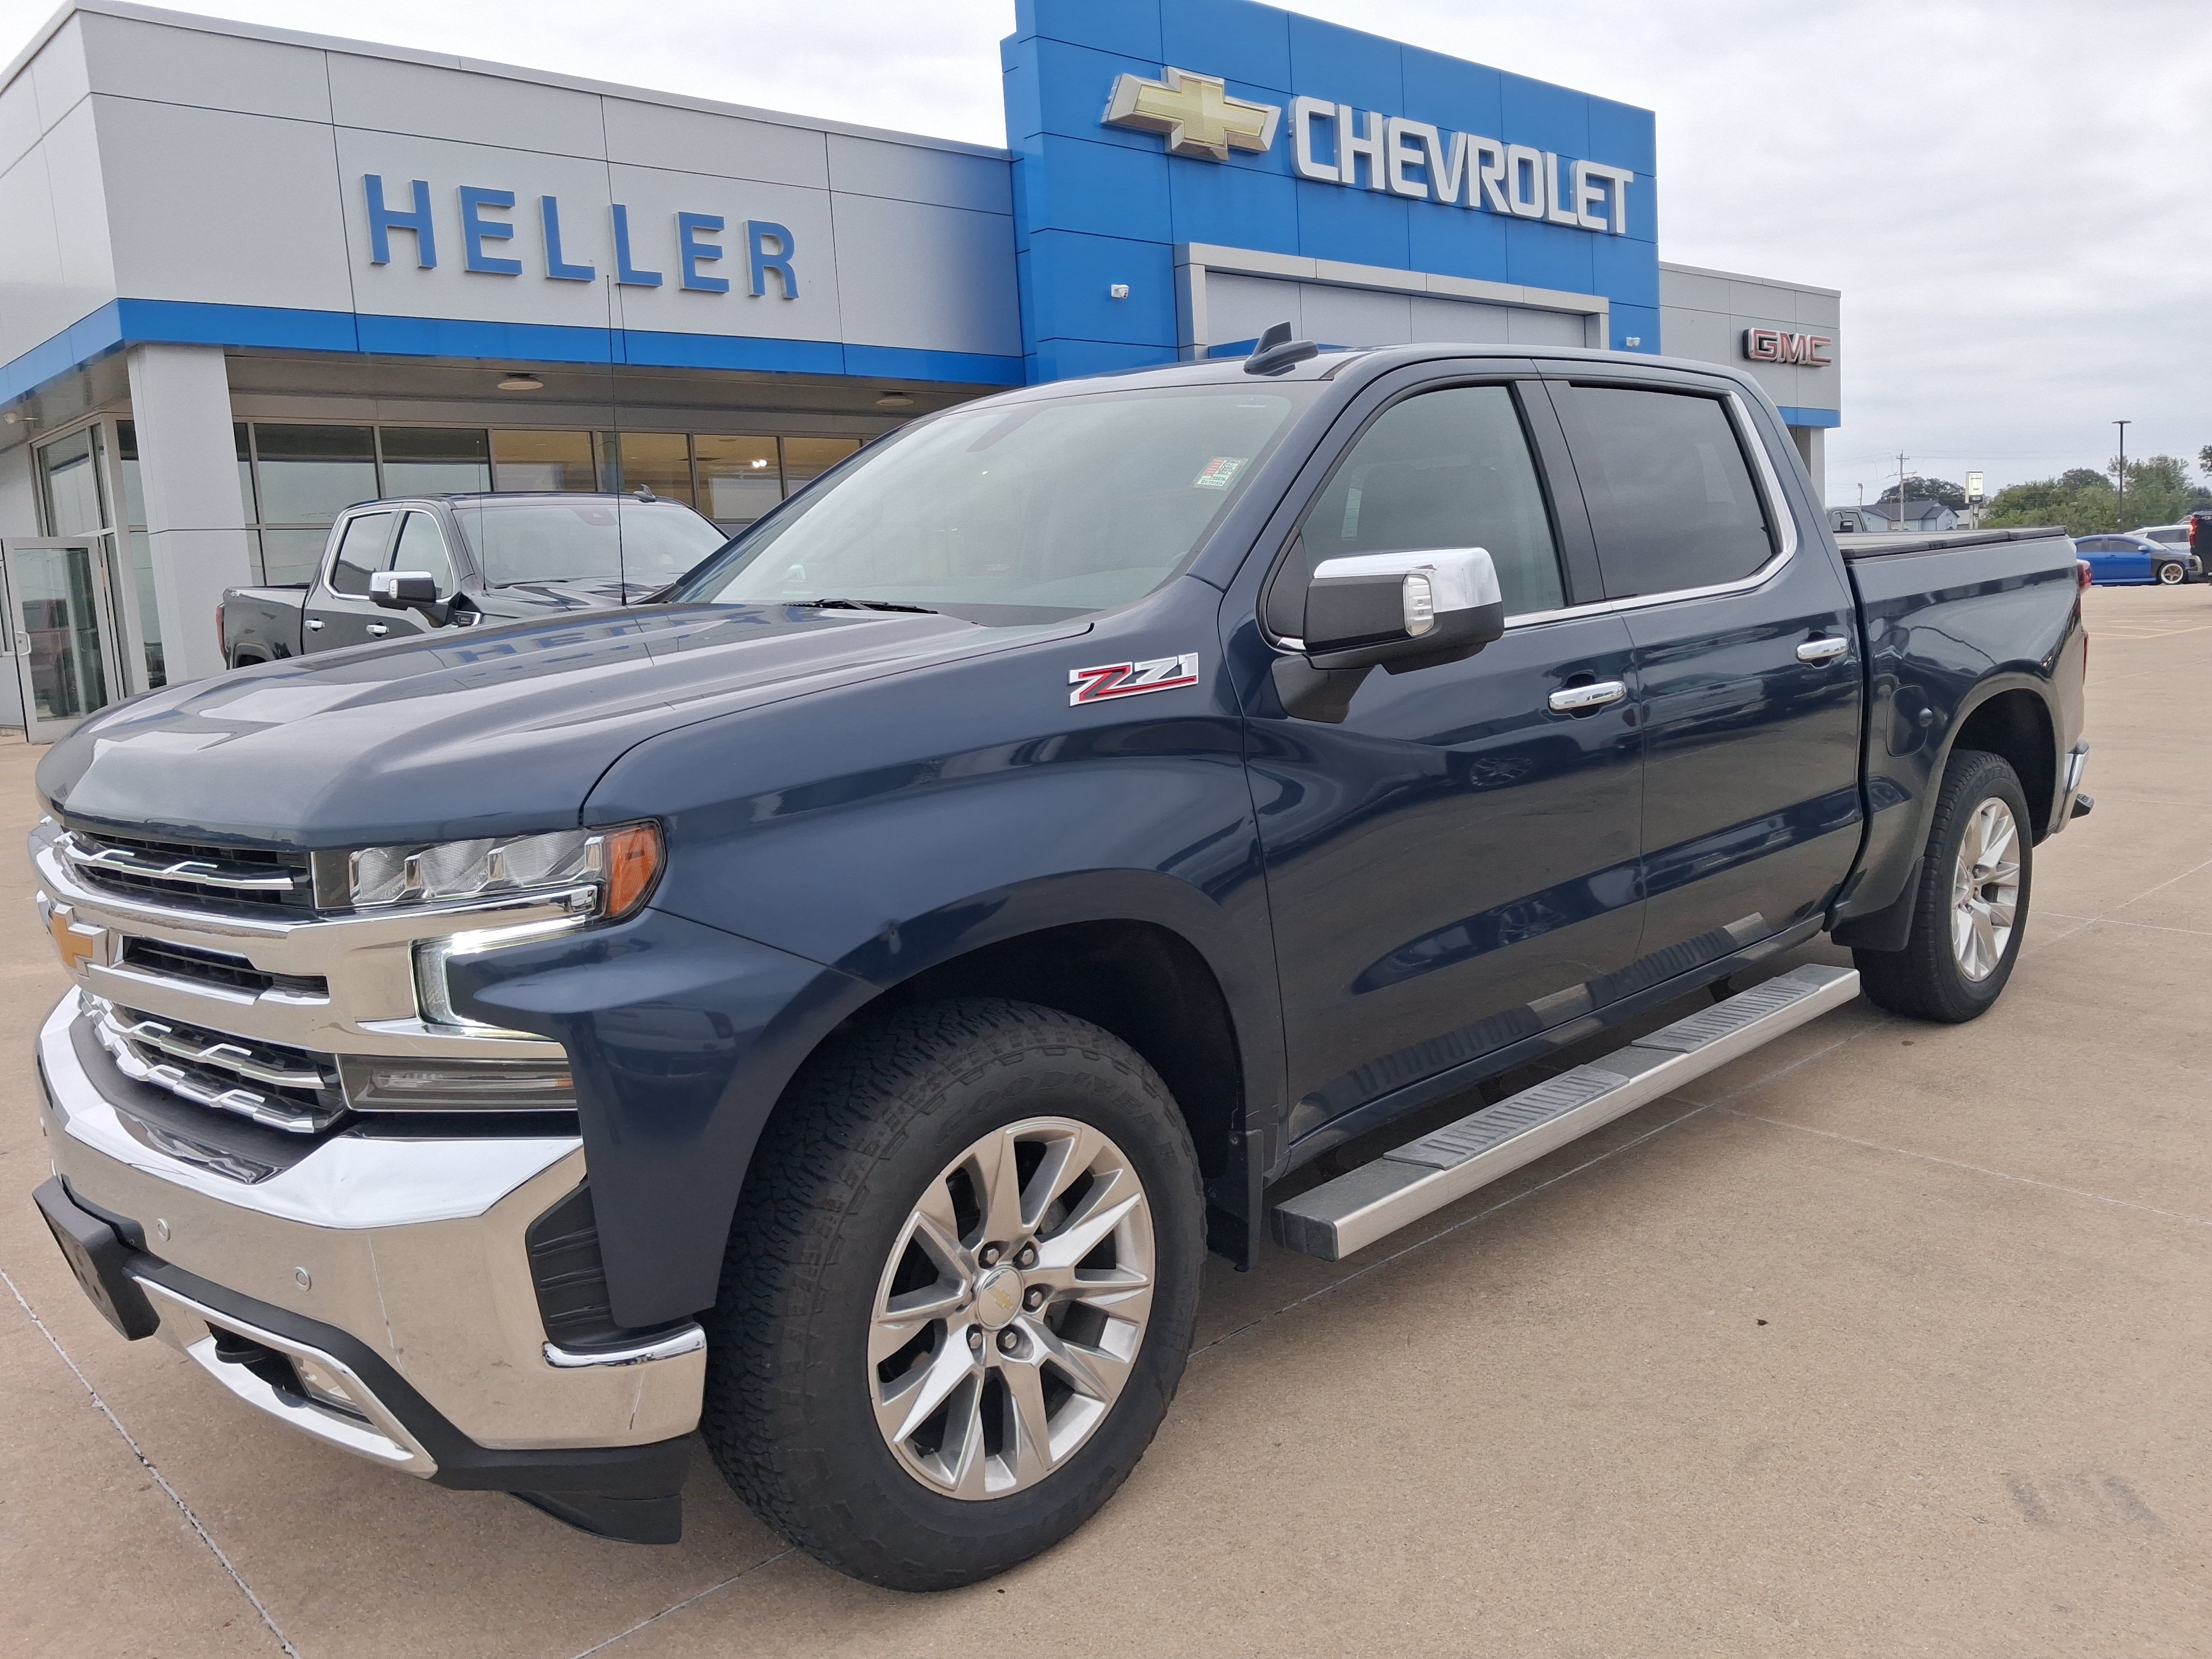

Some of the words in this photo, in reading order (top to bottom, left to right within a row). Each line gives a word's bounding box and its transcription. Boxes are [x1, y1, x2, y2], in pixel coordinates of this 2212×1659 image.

[1288, 95, 1634, 234] CHEVROLET
[361, 173, 799, 299] HELLER
[1742, 327, 1832, 367] GMC
[1068, 652, 1199, 707] Z71
[935, 1070, 1179, 1165] GOODYEAR
